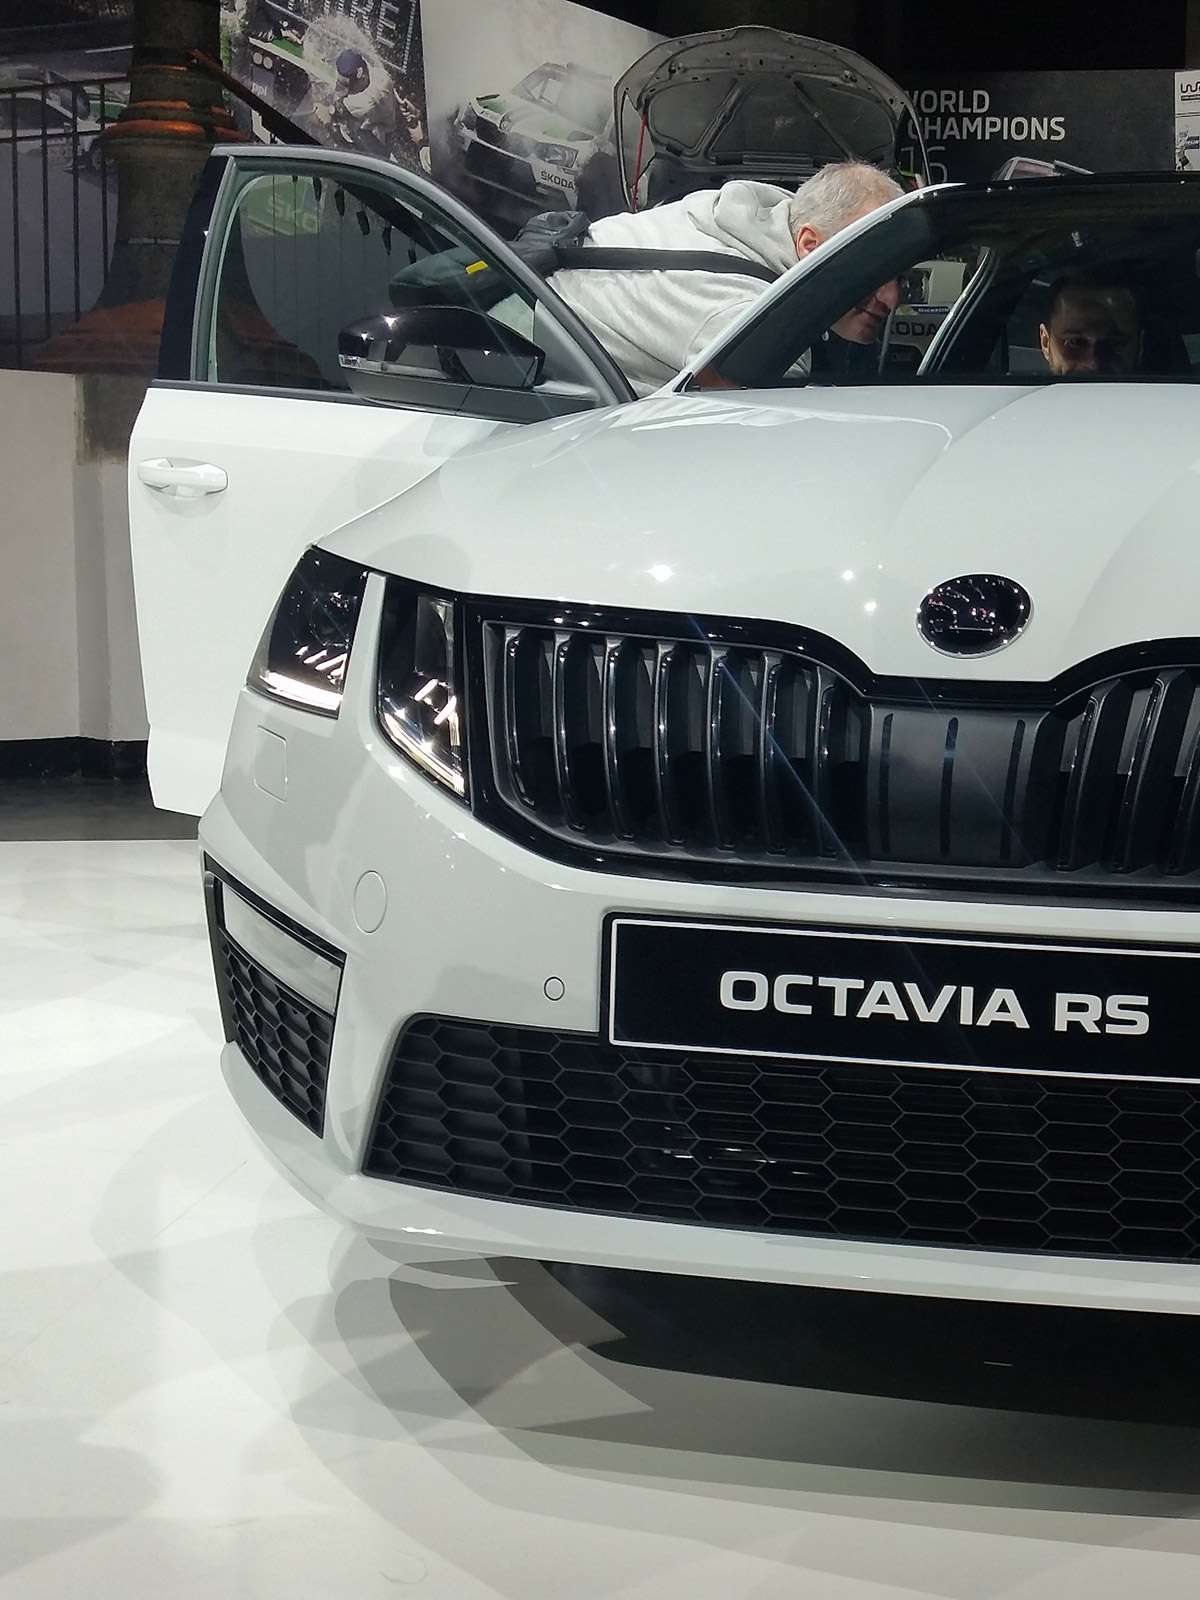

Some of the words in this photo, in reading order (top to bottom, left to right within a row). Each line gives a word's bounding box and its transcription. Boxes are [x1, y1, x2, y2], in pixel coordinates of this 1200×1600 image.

[907, 117, 1066, 141] CHAMPIONS
[719, 970, 1030, 1029] OCTAVIA
[1054, 992, 1150, 1035] RS
